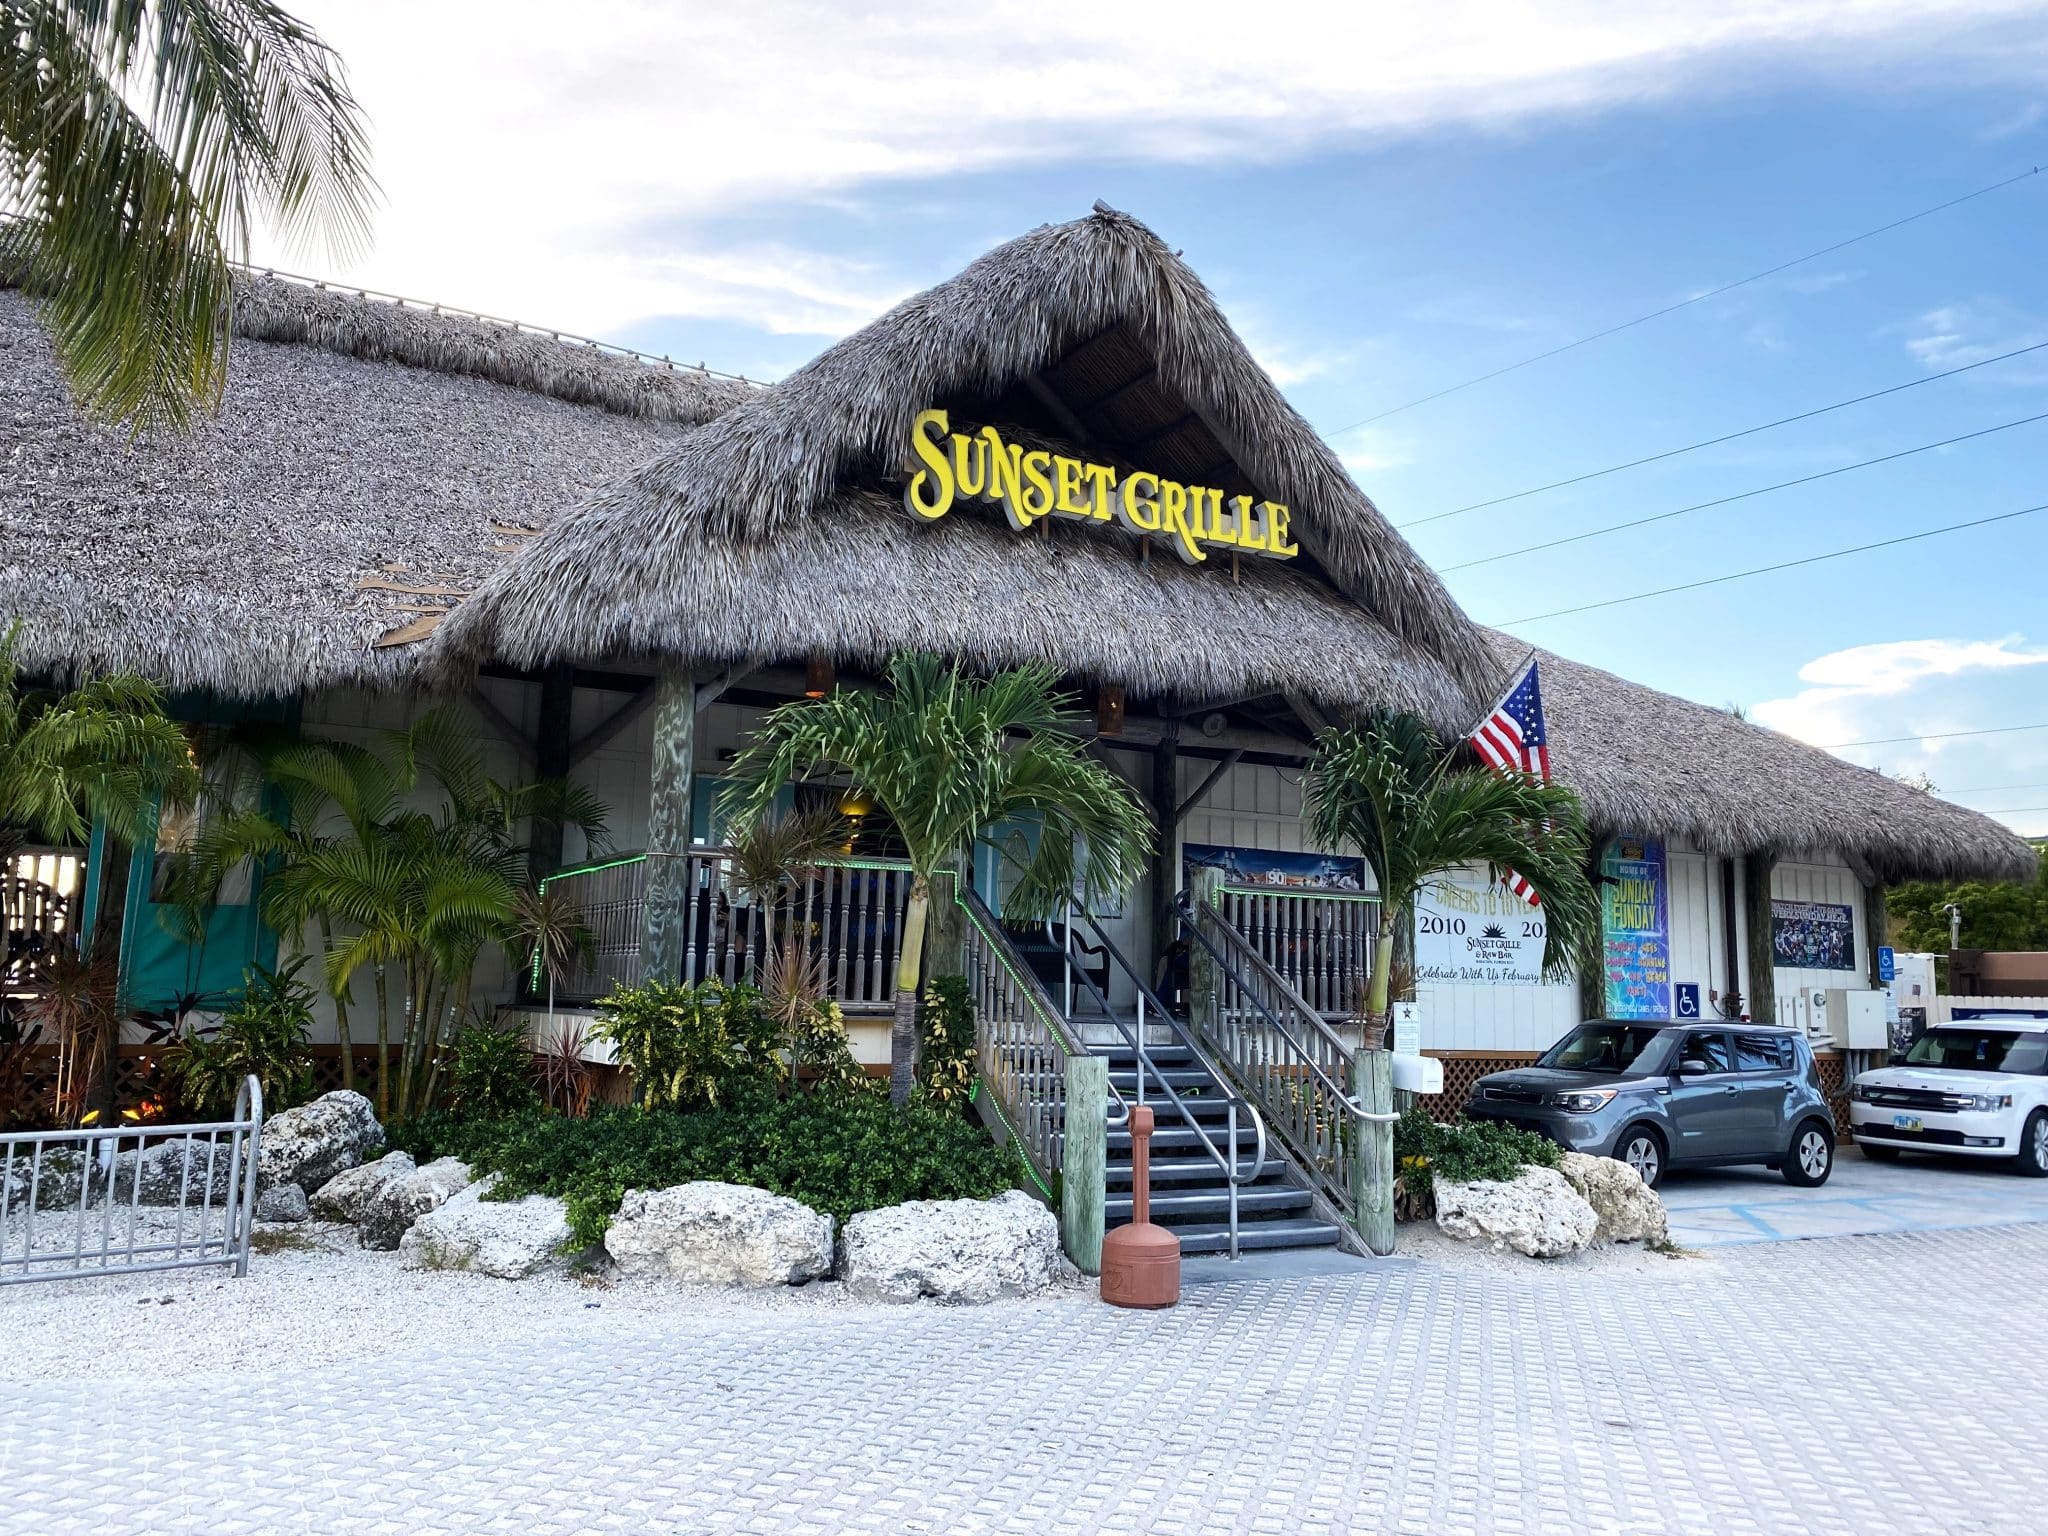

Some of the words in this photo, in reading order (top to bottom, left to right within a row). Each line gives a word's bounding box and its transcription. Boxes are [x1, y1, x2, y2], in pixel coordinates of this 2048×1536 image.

[905, 409, 1116, 531] SUNSET
[1117, 471, 1299, 565] GRILLE
[1620, 865, 1638, 874] HOME
[1640, 866, 1648, 875] OF
[1436, 881, 1480, 914] CHEERS
[1482, 892, 1496, 916] TO
[1502, 892, 1514, 916] 10
[1613, 879, 1655, 904] SUNDAY
[1419, 916, 1466, 936] 2010
[1613, 903, 1655, 929] FUNDAY
[1466, 936, 1495, 952] SUNSET
[1495, 939, 1521, 951] GRILLE
[1416, 965, 1458, 980] Celebrate
[1460, 966, 1484, 980] With
[1486, 967, 1499, 981] Us
[1502, 968, 1539, 982] February
